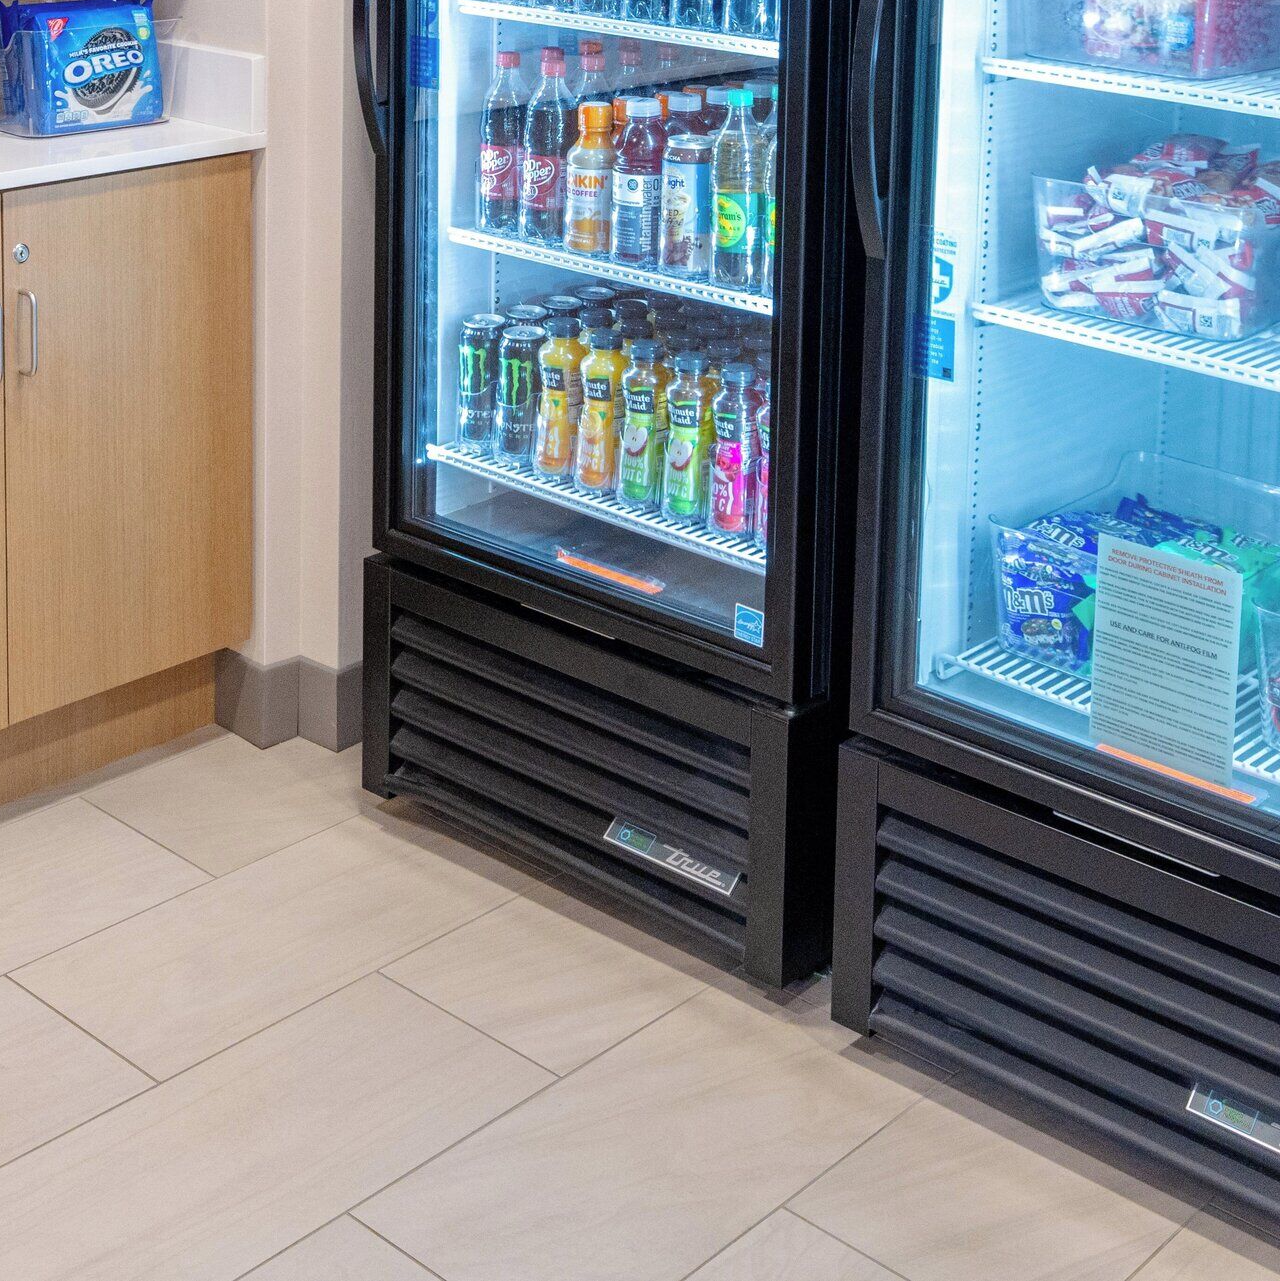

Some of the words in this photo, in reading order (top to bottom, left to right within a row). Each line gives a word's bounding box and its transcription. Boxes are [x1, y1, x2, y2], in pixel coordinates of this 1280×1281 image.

[63, 50, 144, 84] OREO
[88, 44, 116, 54] FAVORITE
[572, 189, 598, 198] COFFEE
[1108, 555, 1127, 566] DOOR
[1127, 561, 1153, 574] DURING
[1153, 568, 1181, 582] CABINET
[1181, 576, 1227, 596] INSTALLATION
[1111, 548, 1138, 561] REMOVE
[1139, 555, 1177, 573] PROTECTIVE
[1178, 568, 1204, 580] SHEATH
[1204, 575, 1224, 587] FROM
[1110, 620, 1122, 629] USE
[1122, 623, 1138, 634] AND
[1138, 628, 1156, 640] CARE
[1156, 634, 1170, 644] FOR
[1202, 649, 1218, 660] FILM
